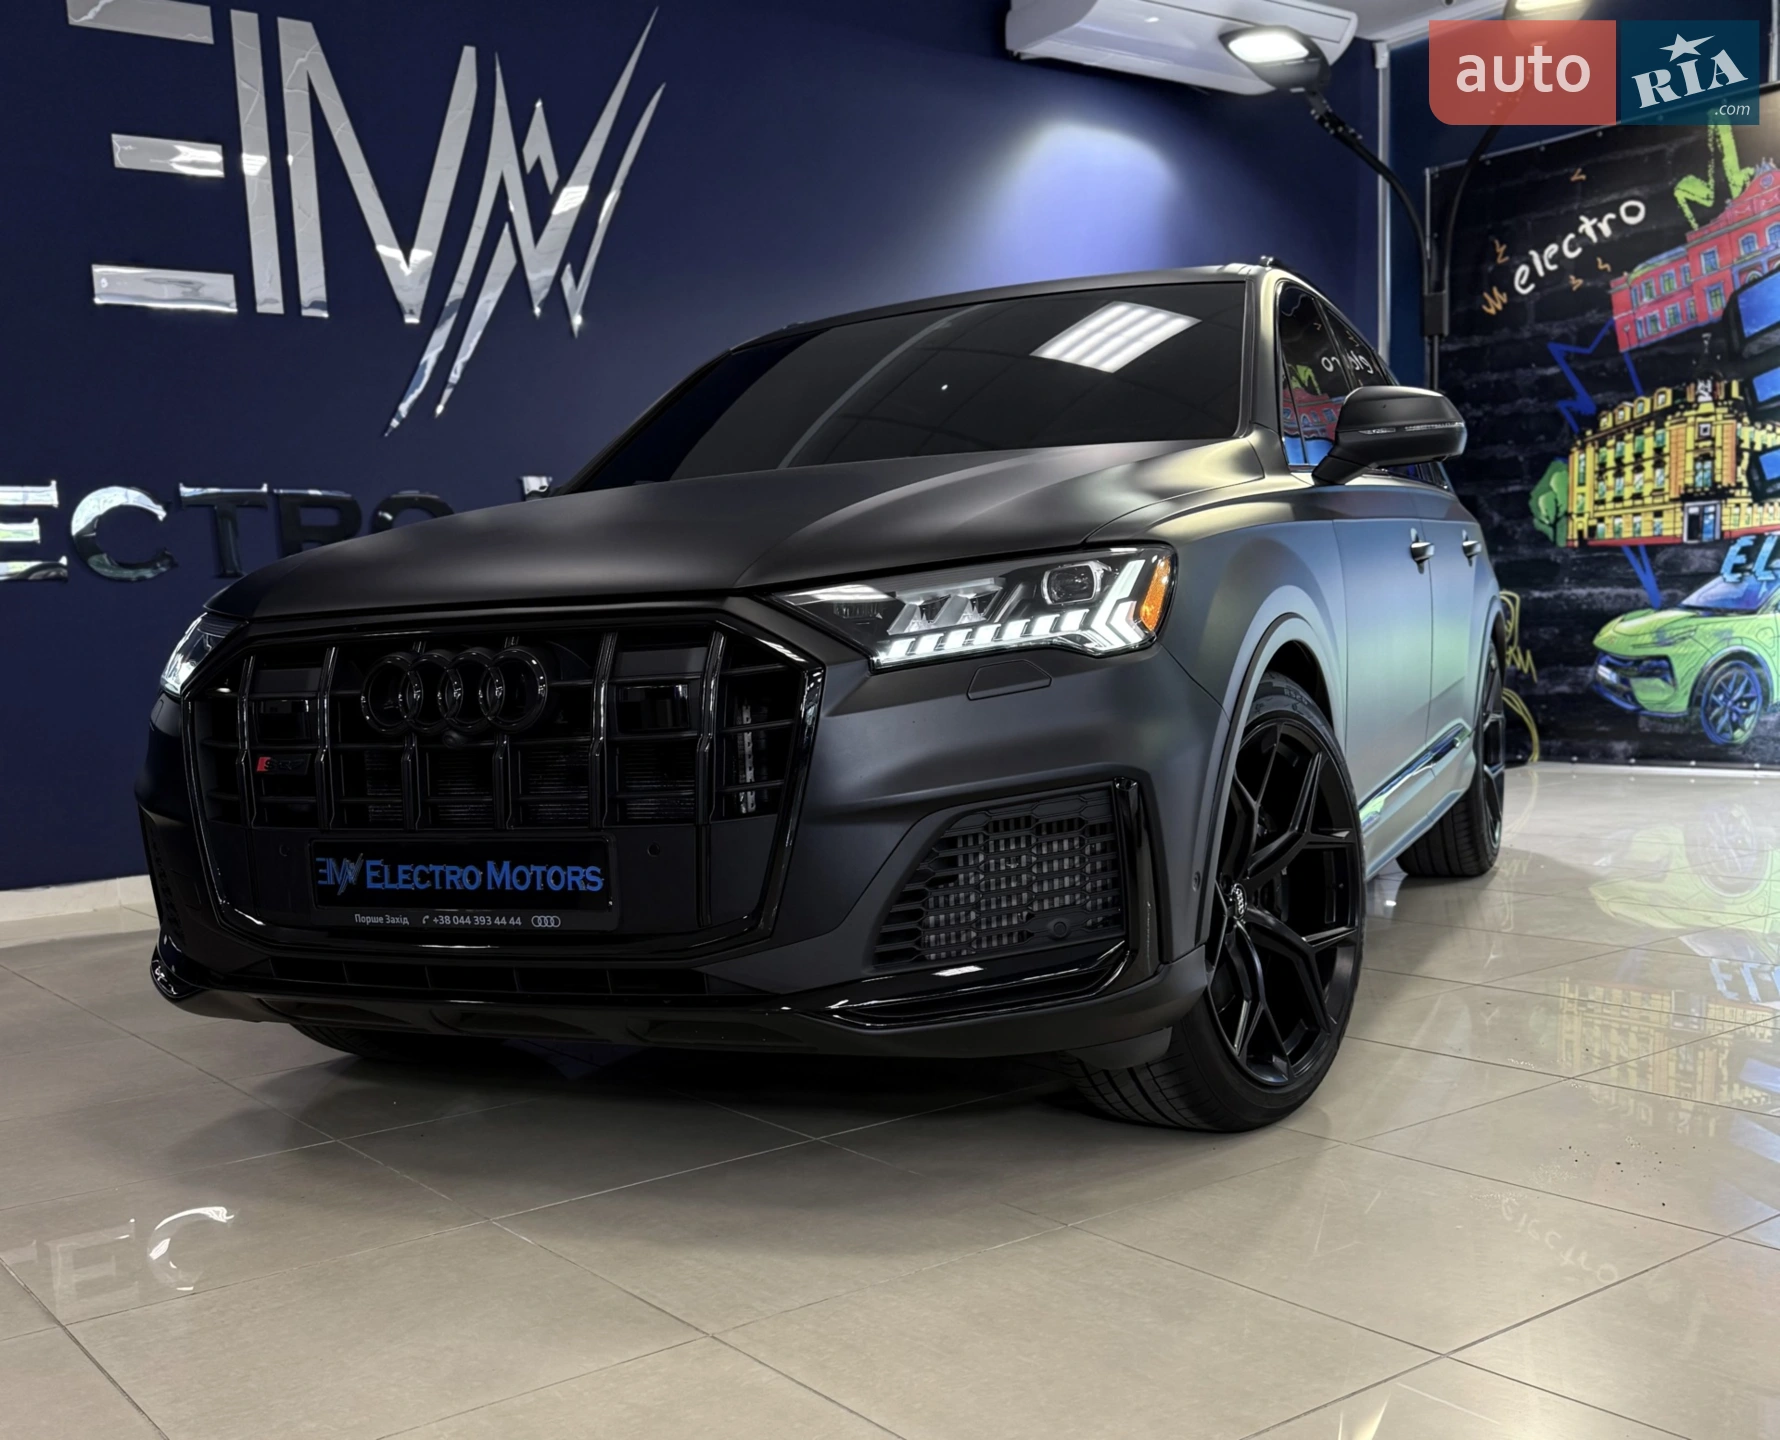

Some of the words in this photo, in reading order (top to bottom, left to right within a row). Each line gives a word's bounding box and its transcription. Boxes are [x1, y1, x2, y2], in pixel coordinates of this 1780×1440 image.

[1513, 200, 1646, 295] electro
[365, 859, 483, 891] ELECTRO
[487, 860, 605, 892] MOTORS
[354, 913, 384, 926] Порше
[385, 914, 410, 926] Захід
[432, 915, 451, 925] +38
[452, 915, 472, 925] 044
[473, 915, 492, 926] 393
[493, 916, 507, 926] 44
[508, 916, 522, 926] 44
